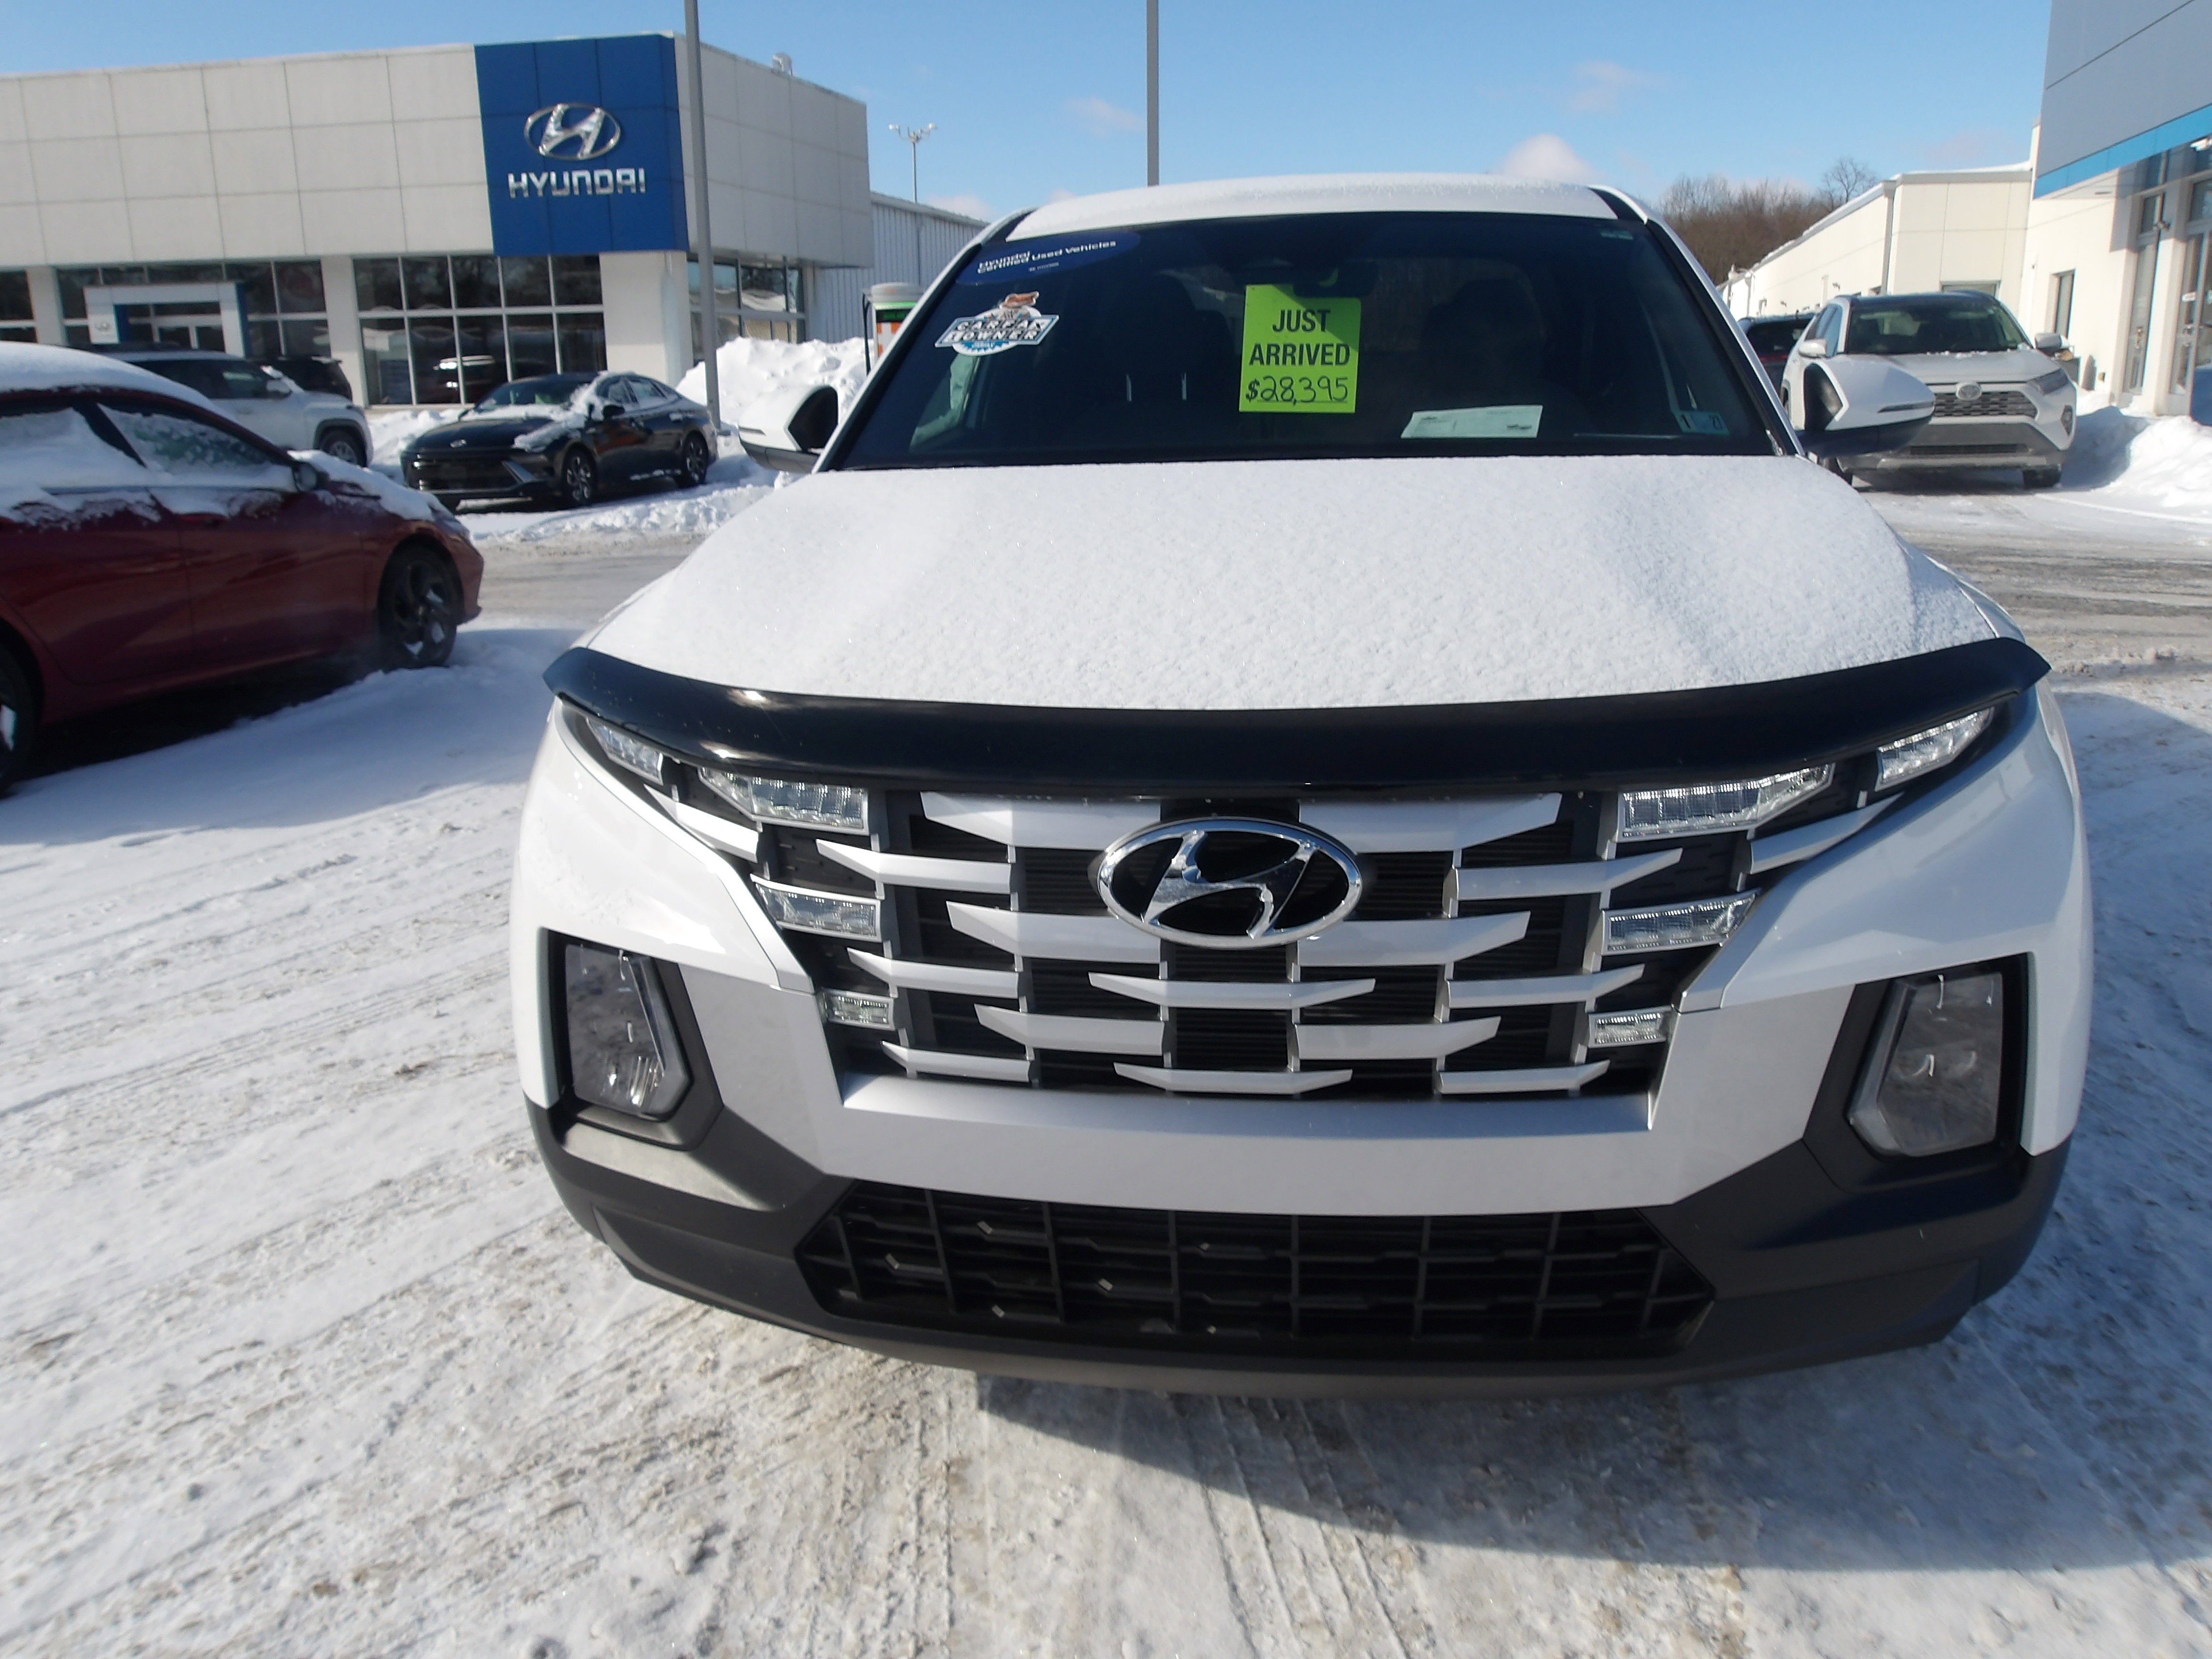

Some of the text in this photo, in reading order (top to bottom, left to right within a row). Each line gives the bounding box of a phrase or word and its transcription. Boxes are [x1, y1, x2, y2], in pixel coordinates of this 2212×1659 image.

[508, 168, 646, 198] HYUNDAI
[1032, 249, 1063, 261] Used
[1065, 241, 1116, 253] Vehicles
[1272, 310, 1331, 332] JUST
[1249, 343, 1350, 366] ARRIVED
[1245, 375, 1348, 405] $28,395
